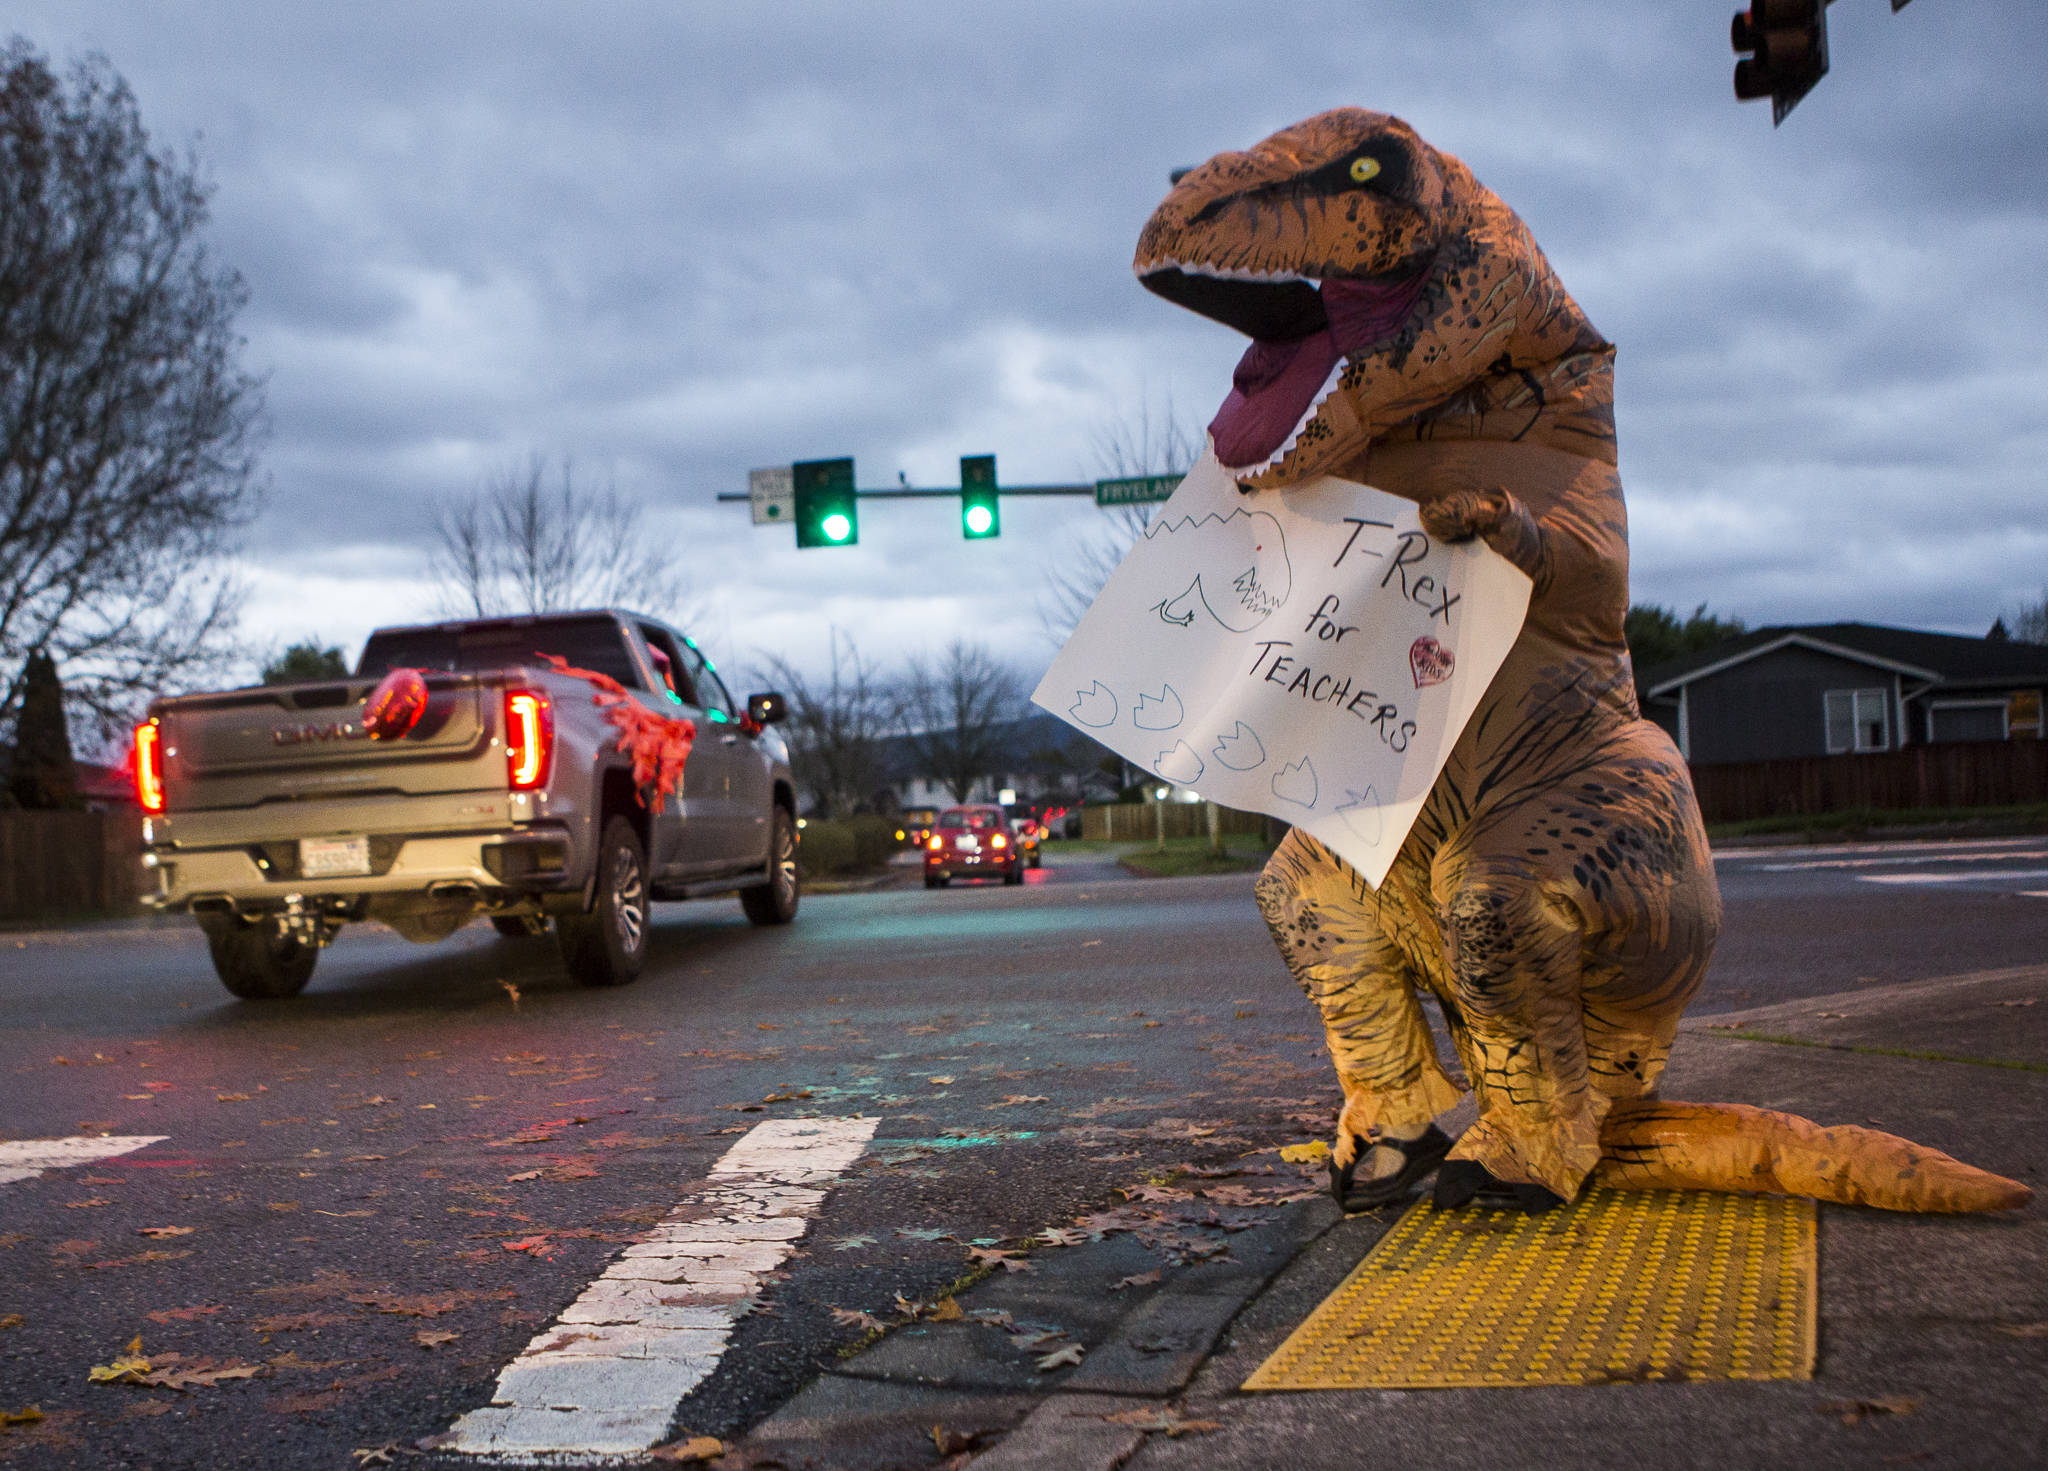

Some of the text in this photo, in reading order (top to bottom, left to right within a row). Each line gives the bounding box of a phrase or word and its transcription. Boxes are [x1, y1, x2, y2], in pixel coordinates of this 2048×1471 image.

[1304, 594, 1361, 643] for
[1333, 516, 1461, 625] T-Rex
[1249, 641, 1417, 753] TEACHERS
